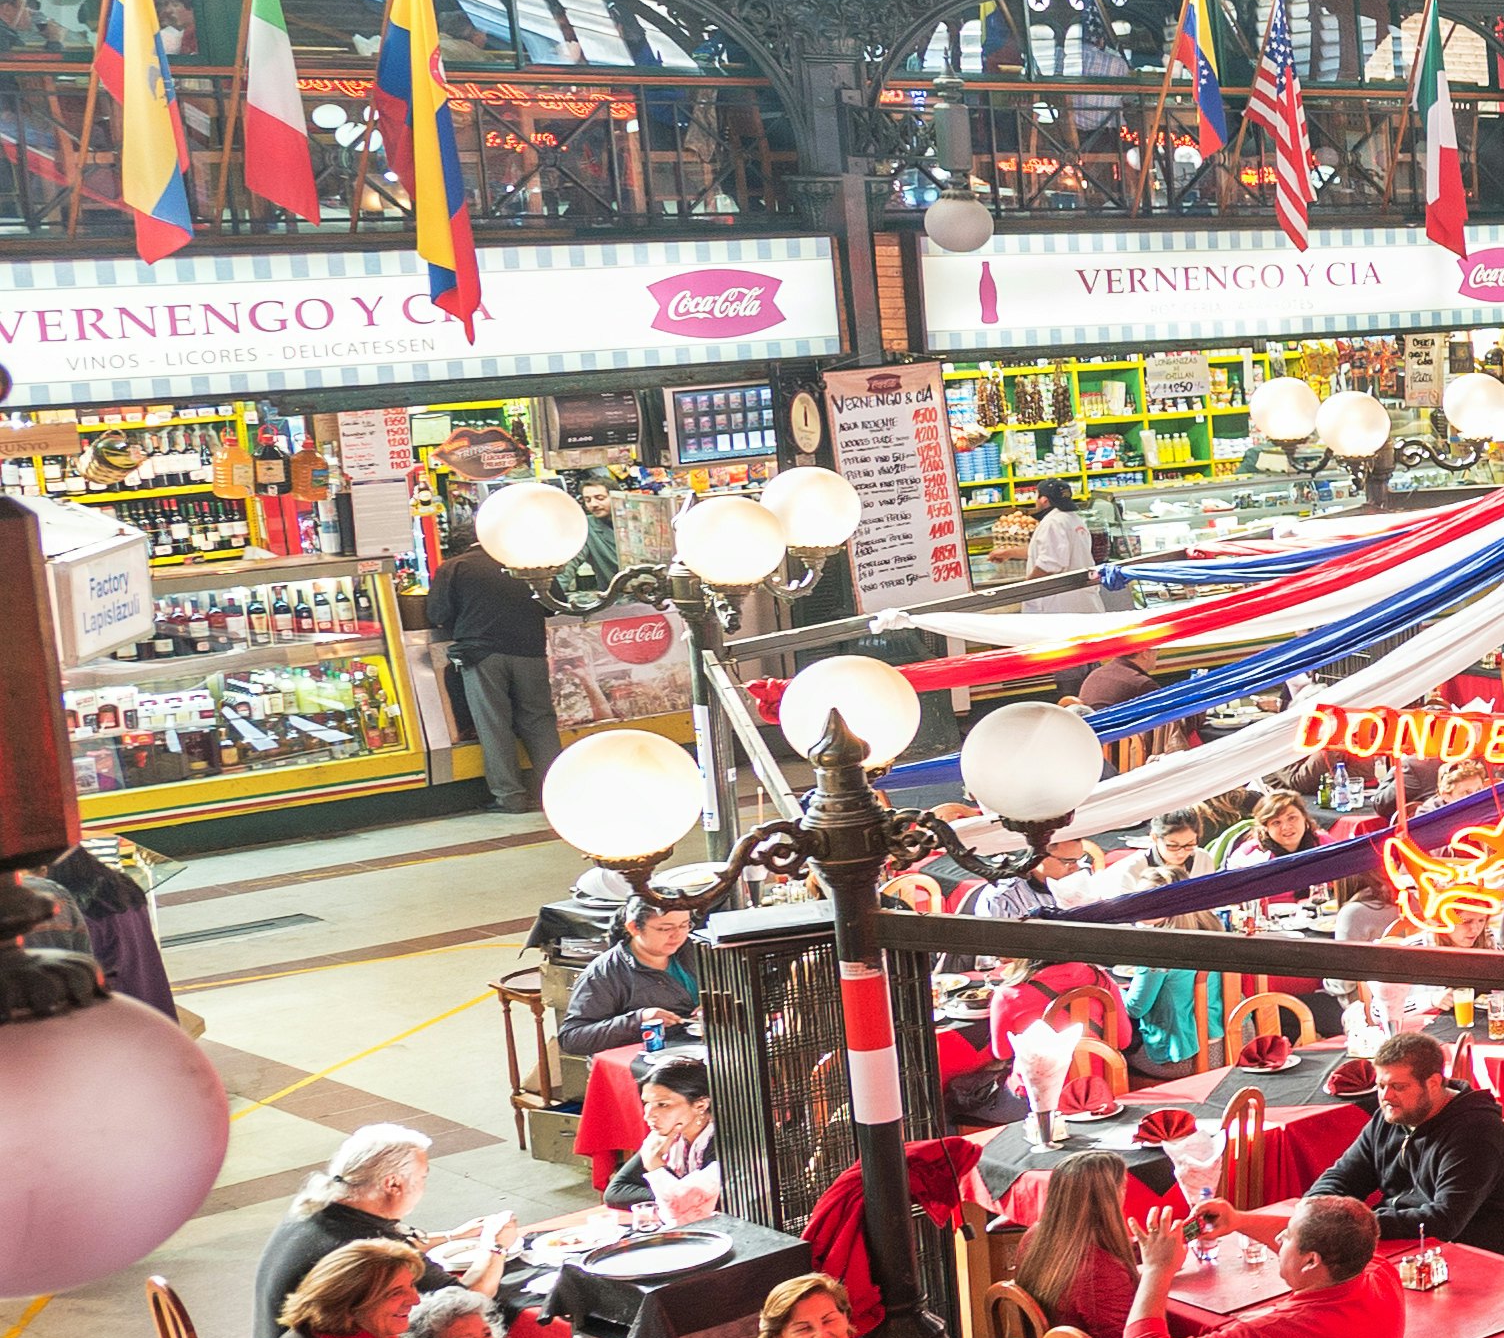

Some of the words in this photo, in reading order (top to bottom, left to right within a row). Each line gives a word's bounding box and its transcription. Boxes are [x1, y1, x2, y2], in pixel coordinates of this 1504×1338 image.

[1075, 264, 1285, 294] VERNENGO
[1296, 262, 1316, 290] Y
[1326, 260, 1383, 288] CIA
[351, 295, 384, 327] Y
[667, 285, 765, 322] Coca-Cola
[66, 353, 140, 371] VINOS
[166, 346, 258, 368] LICORES
[282, 337, 436, 361] DELICATESSEN
[831, 391, 903, 415] VERNENGO
[904, 391, 913, 405] &
[89, 571, 129, 601] Factory
[606, 621, 667, 647] Coca-Cola
